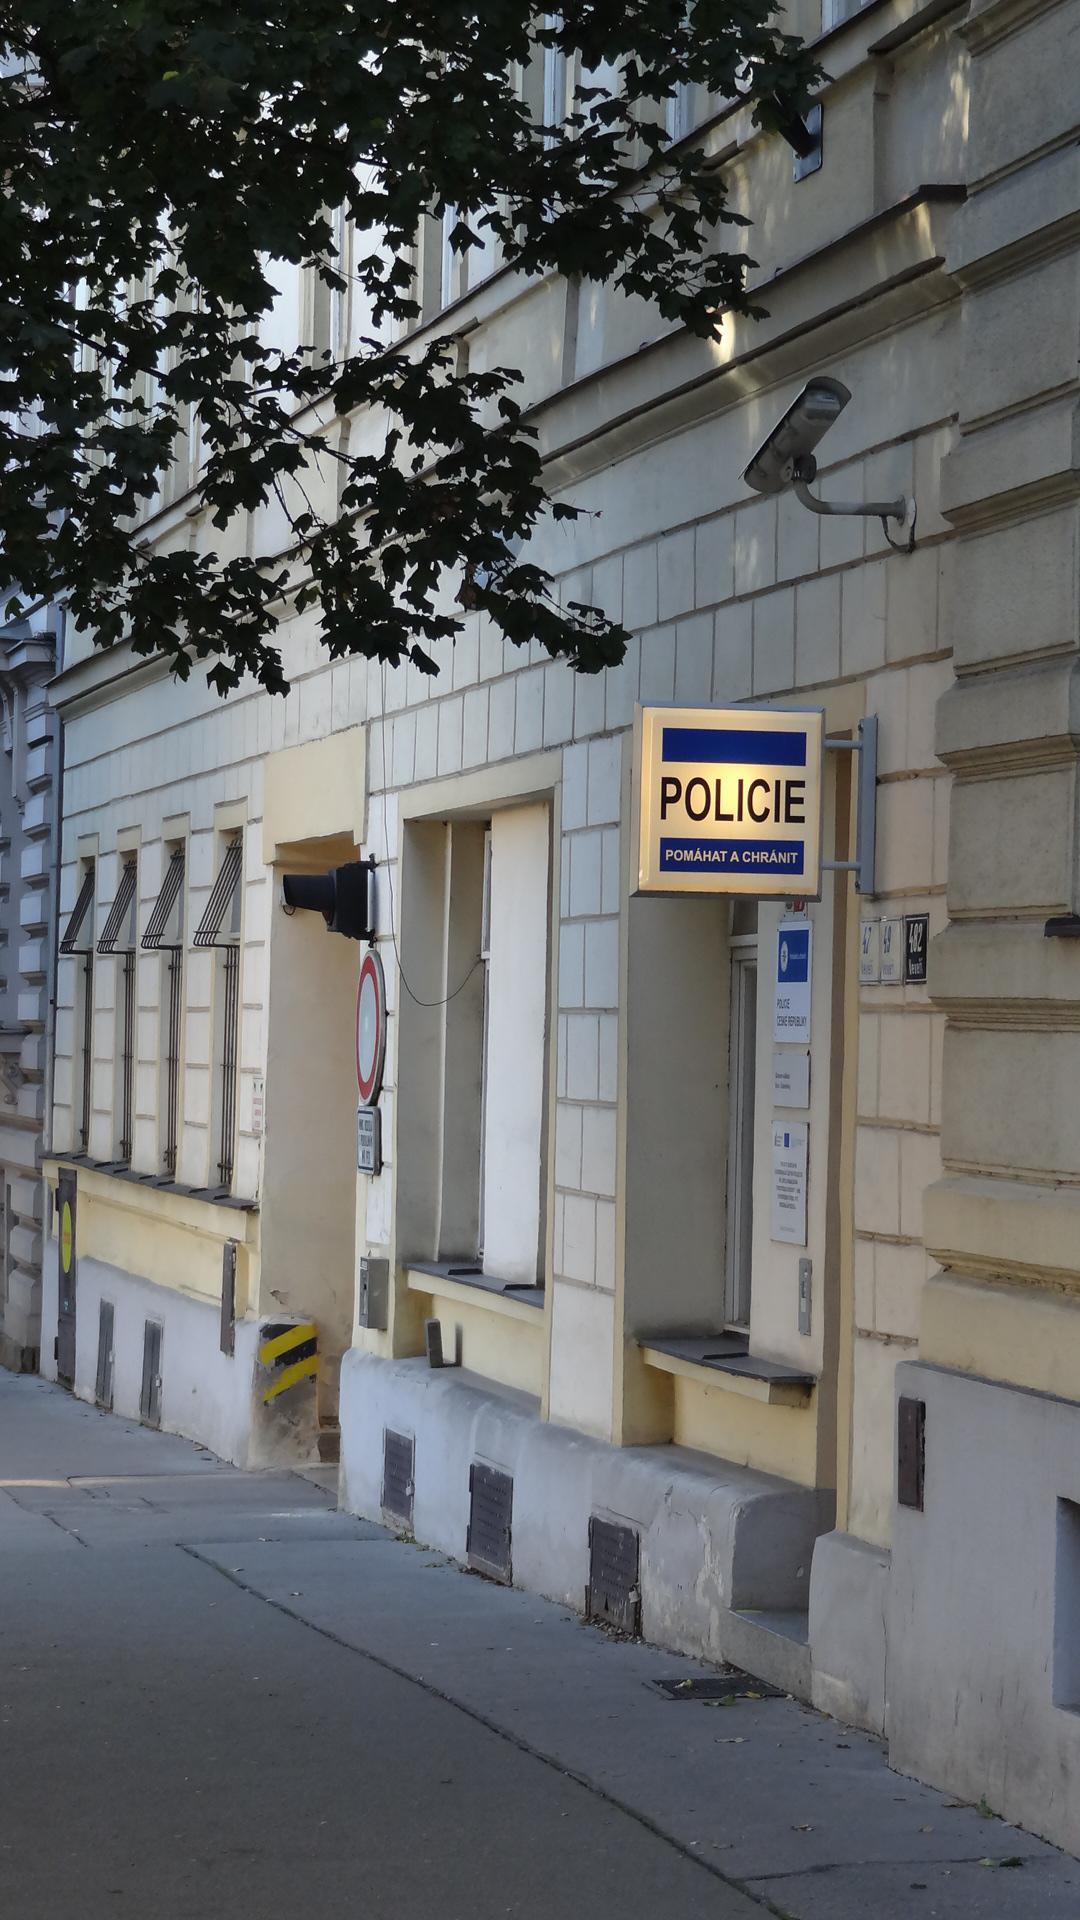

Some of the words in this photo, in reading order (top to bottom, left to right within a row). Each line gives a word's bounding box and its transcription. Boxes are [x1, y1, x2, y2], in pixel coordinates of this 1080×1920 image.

[660, 776, 806, 823] POLICIE
[665, 848, 728, 862] POMÁHAT
[730, 851, 740, 862] A
[742, 850, 799, 864] CHRÁNIT
[863, 926, 872, 954] 47
[908, 923, 923, 953] 482
